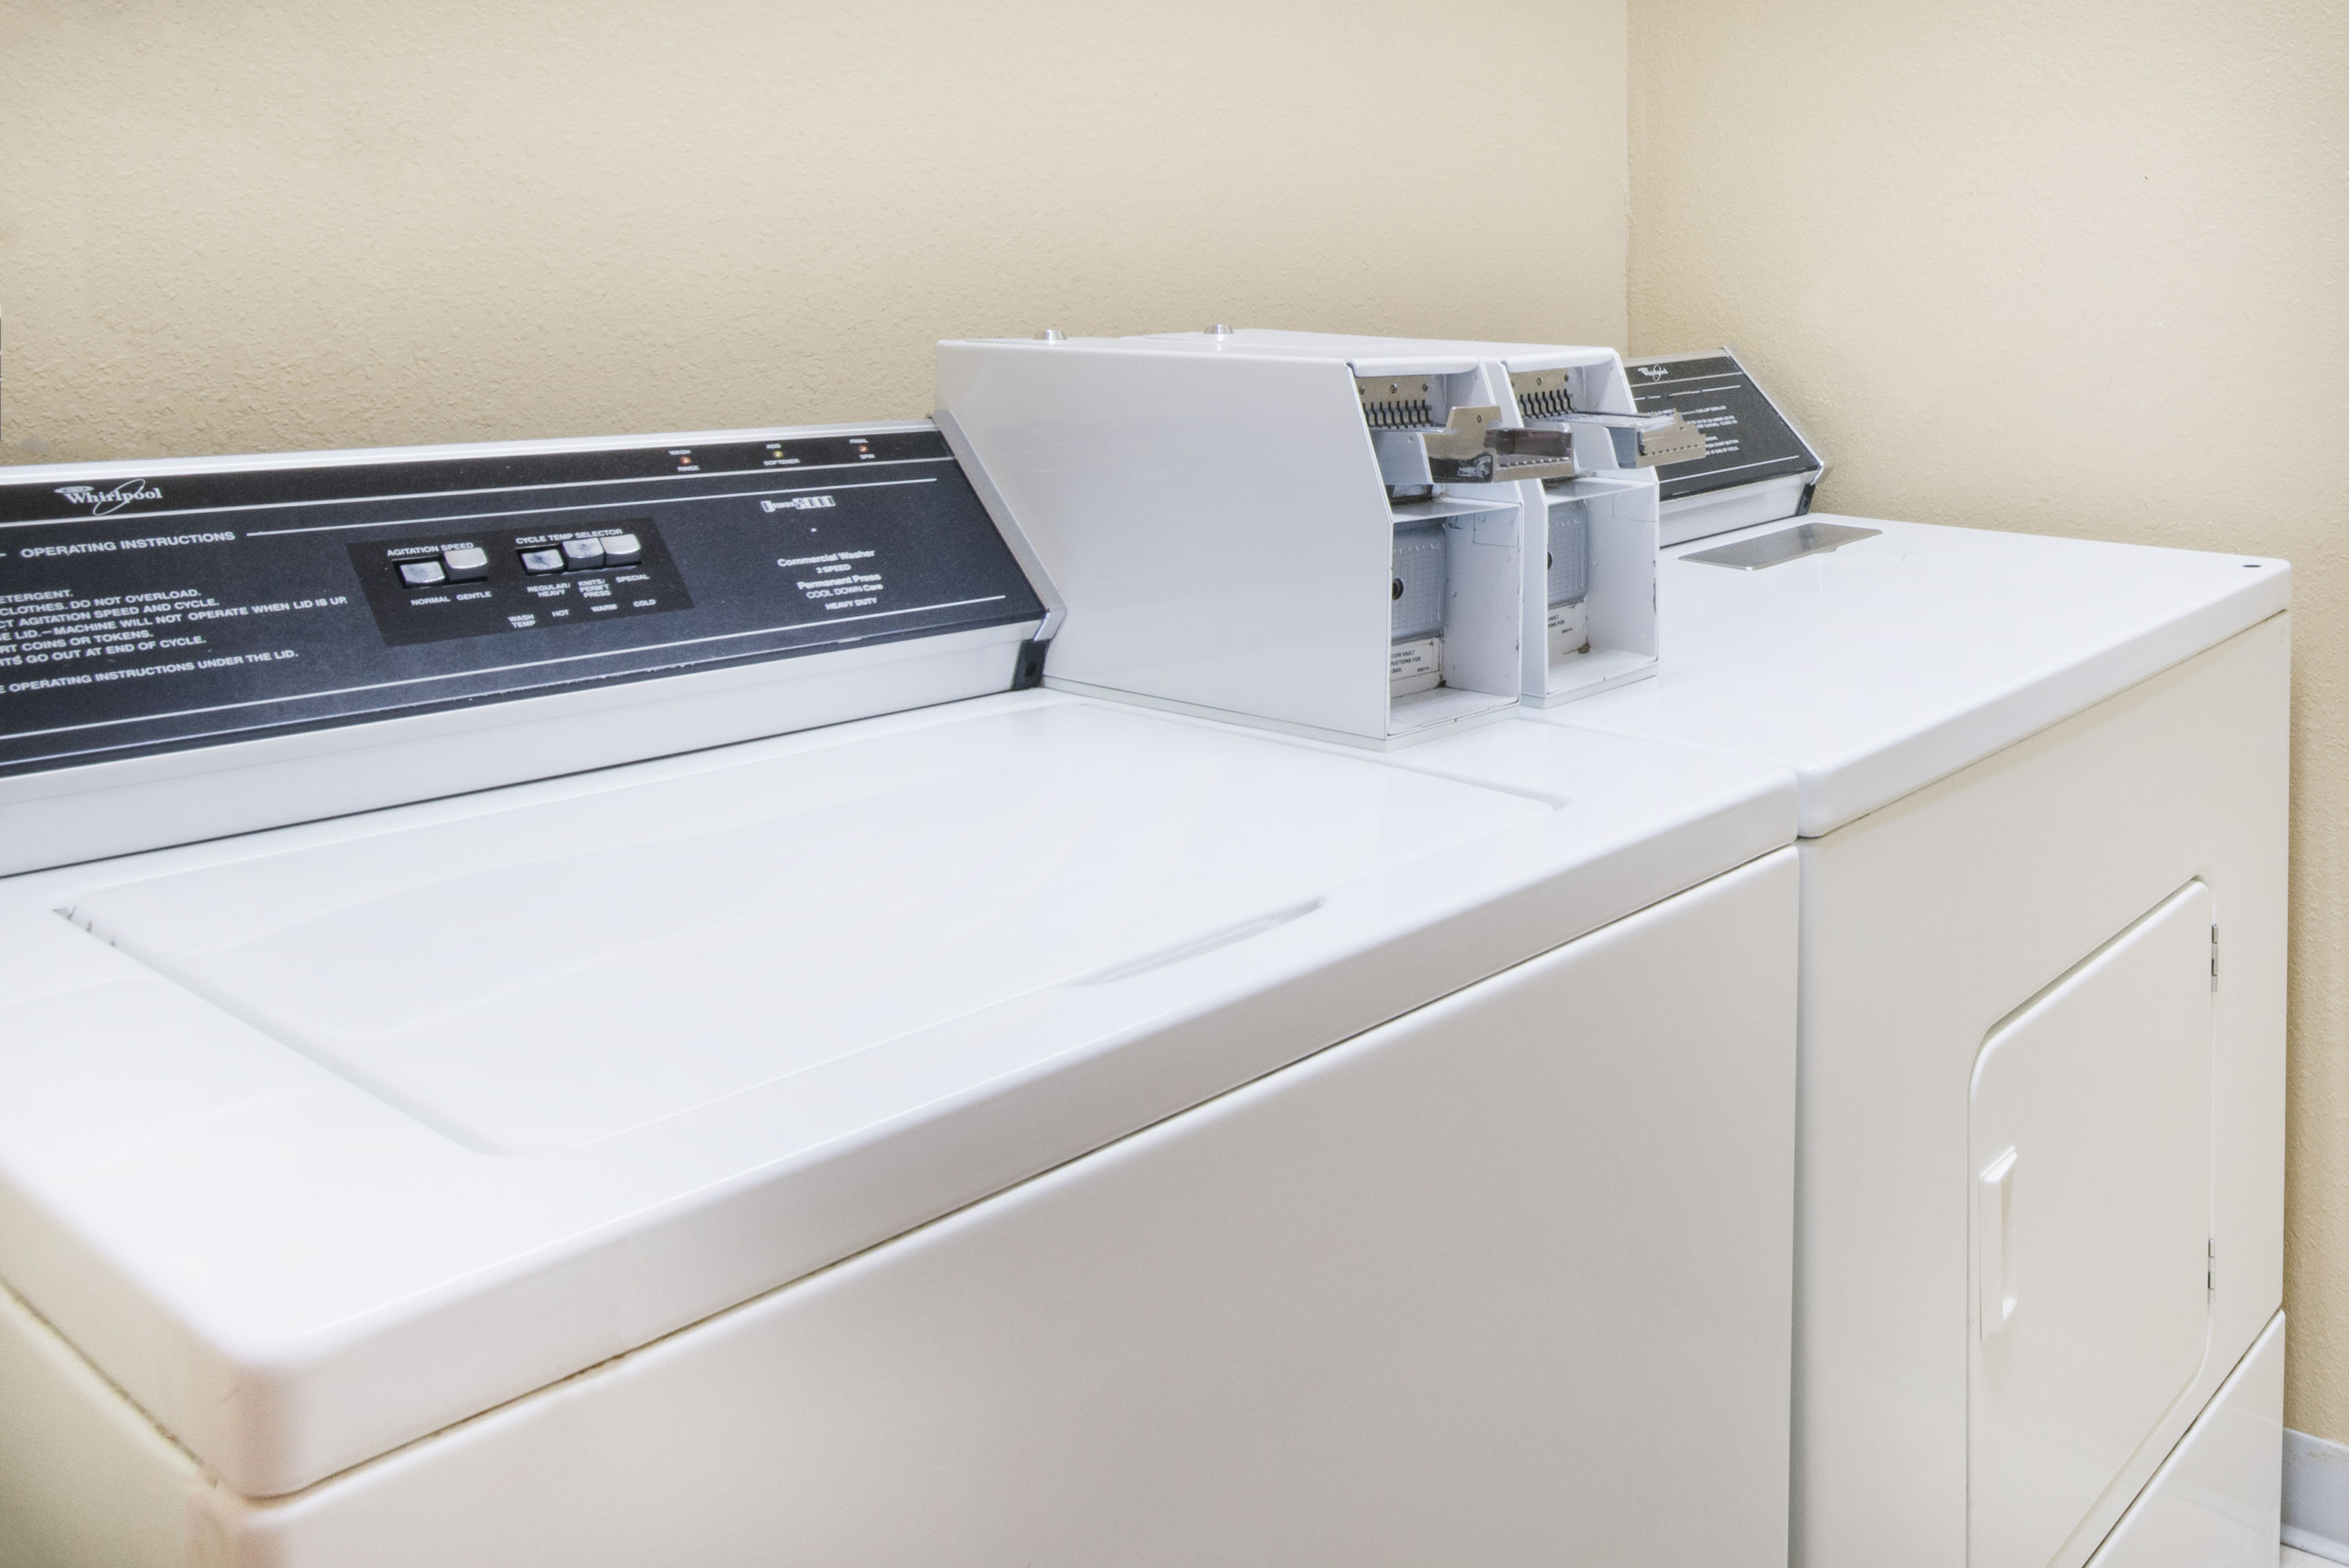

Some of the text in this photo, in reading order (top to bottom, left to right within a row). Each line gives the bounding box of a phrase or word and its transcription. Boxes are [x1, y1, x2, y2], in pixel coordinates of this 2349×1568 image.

[63, 487, 164, 504] Whirlpool
[515, 528, 623, 545] CYCLE TEMP SELECTOR
[20, 532, 236, 557] OPERATING INSTRUCTIONS
[387, 542, 474, 557] AGITATION SPEED
[777, 550, 875, 567] Commercial Washer
[822, 564, 852, 573] SPEED
[615, 574, 651, 582] SPECIAL
[796, 574, 882, 589] Permanent Press
[456, 590, 493, 601] GENTLE
[537, 589, 565, 598] HEAVY
[583, 589, 612, 598] PRESS
[806, 589, 834, 599] COOL
[833, 586, 863, 595] DOWN
[0, 589, 202, 616] CLOTHES. DO NOT OVERLOAD.
[410, 596, 451, 606] NORMAL
[590, 604, 619, 612] WARM
[633, 599, 657, 607] COLD
[824, 597, 878, 610] HEAVY DUTY
[18, 611, 92, 626] AGITATION
[93, 607, 139, 619] SPEED
[143, 603, 171, 614] AND
[174, 598, 220, 610] CYCLE.
[119, 617, 153, 628] WILL
[155, 614, 182, 624] NOT
[188, 607, 249, 621] OPERATE
[251, 602, 290, 614] WHEN
[292, 600, 313, 609] LID
[315, 598, 328, 607] IS
[329, 596, 348, 605] UP.
[507, 614, 535, 622] WASH
[511, 619, 537, 628] TEMP
[21, 639, 67, 651] COINS
[69, 636, 92, 646] OR
[92, 629, 154, 643] TOKENS.
[25, 653, 49, 663] GO
[51, 649, 81, 661] OUT
[85, 647, 102, 657] AT
[104, 643, 135, 655] END
[136, 640, 156, 651] OF
[159, 635, 207, 648] CYCLE.
[9, 675, 92, 692] OPERATING
[94, 661, 196, 681] INSTRUCTIONS
[197, 655, 244, 669] UNDER
[245, 652, 272, 663] THE
[273, 649, 299, 660] LID.
